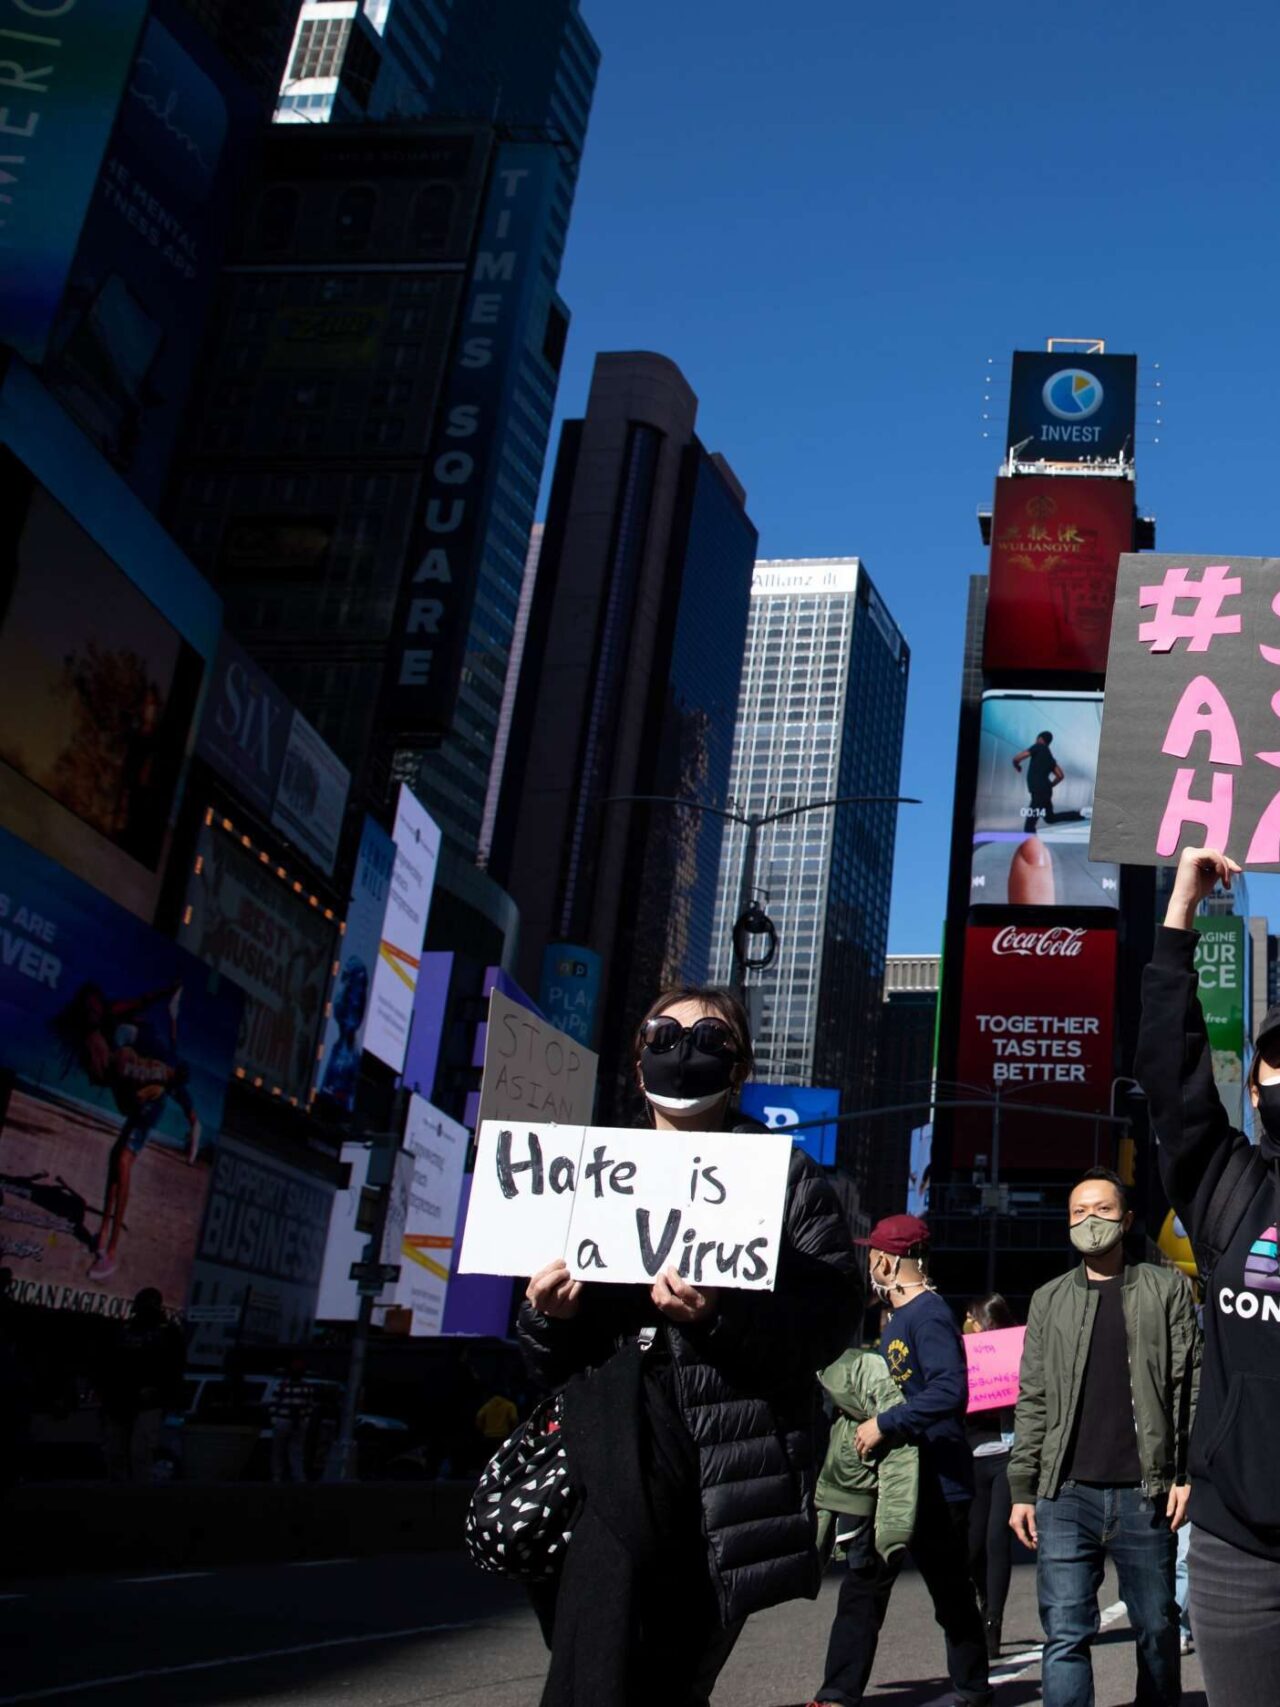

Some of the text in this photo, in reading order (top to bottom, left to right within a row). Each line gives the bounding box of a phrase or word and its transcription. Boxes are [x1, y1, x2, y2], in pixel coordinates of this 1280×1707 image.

[459, 168, 528, 369] TIMES
[1040, 424, 1102, 442] INVEST
[399, 404, 480, 686] SQUARE
[998, 541, 1082, 553] WULIANGYE
[1020, 806, 1046, 818] 00:14
[12, 905, 57, 944] ARE
[992, 925, 1088, 957] Coca-Cola
[0, 926, 62, 990] VER
[499, 1013, 581, 1080] STOP
[976, 1014, 1100, 1035] TOGETHER
[992, 1038, 1083, 1059] TASTES
[495, 1065, 574, 1121] ASIAN
[214, 1154, 284, 1208] SUPPORT
[496, 1129, 637, 1200] Hate
[690, 1156, 727, 1205] is
[202, 1194, 328, 1283] BUSINESS
[577, 1238, 608, 1270] a
